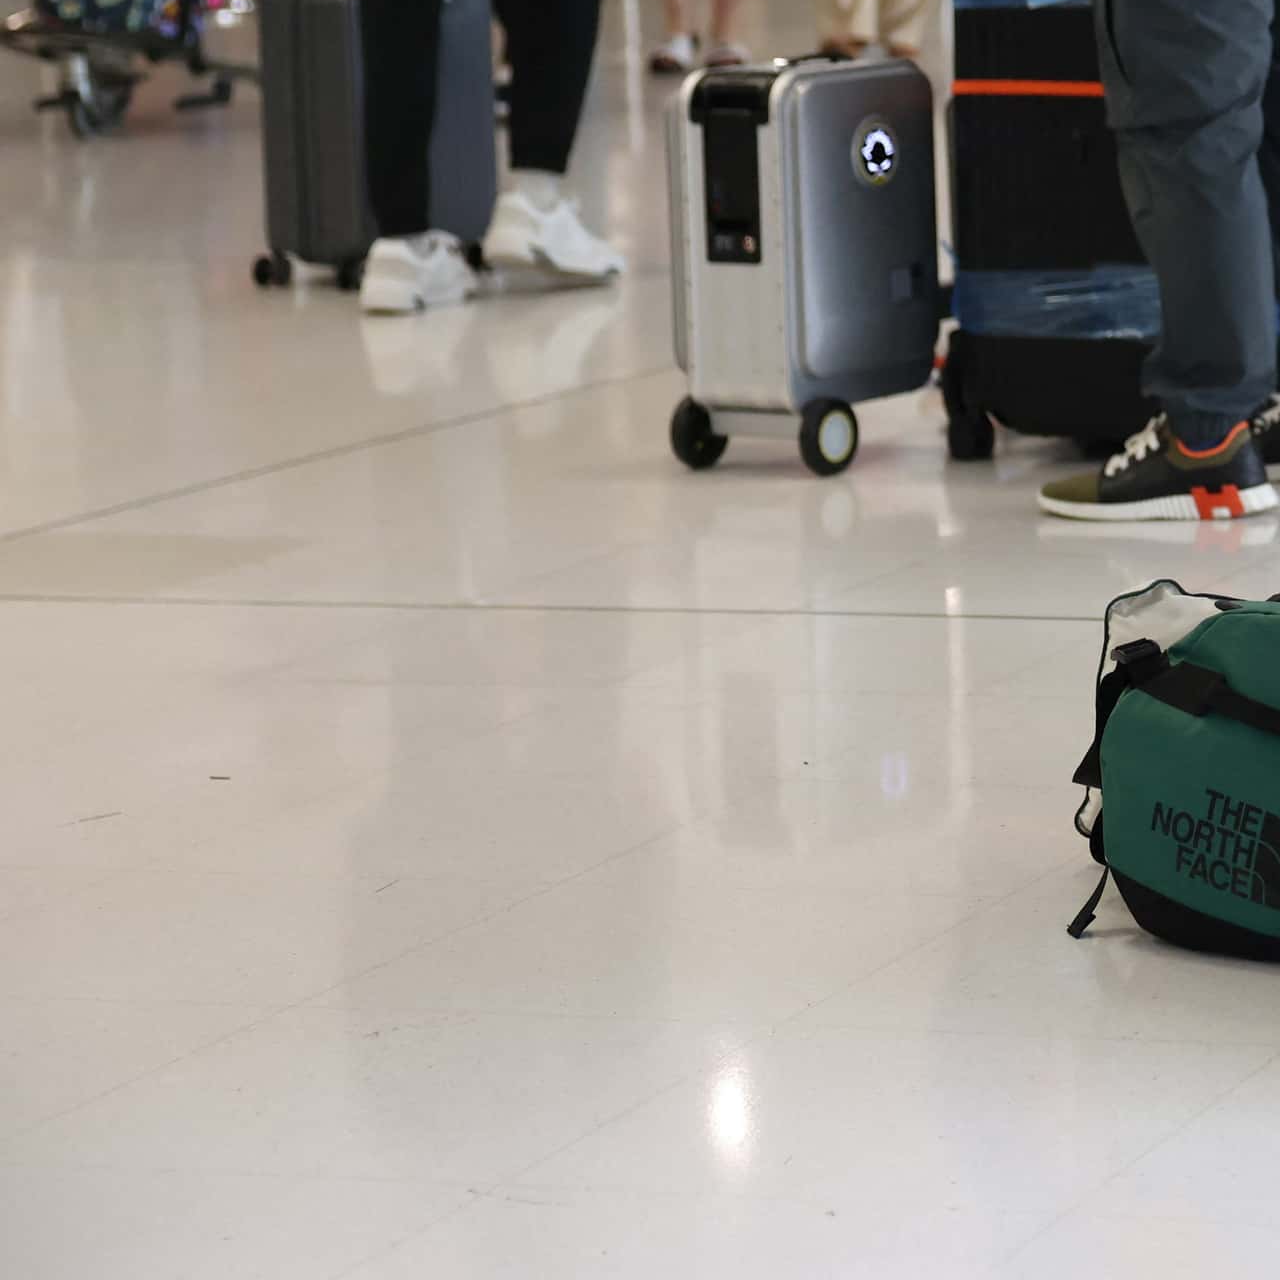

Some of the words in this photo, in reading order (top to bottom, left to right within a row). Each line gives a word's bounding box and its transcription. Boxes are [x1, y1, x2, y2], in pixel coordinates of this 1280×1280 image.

[1151, 801, 1256, 869] NORTH
[1206, 788, 1263, 838] THE
[1175, 844, 1250, 899] FACE
